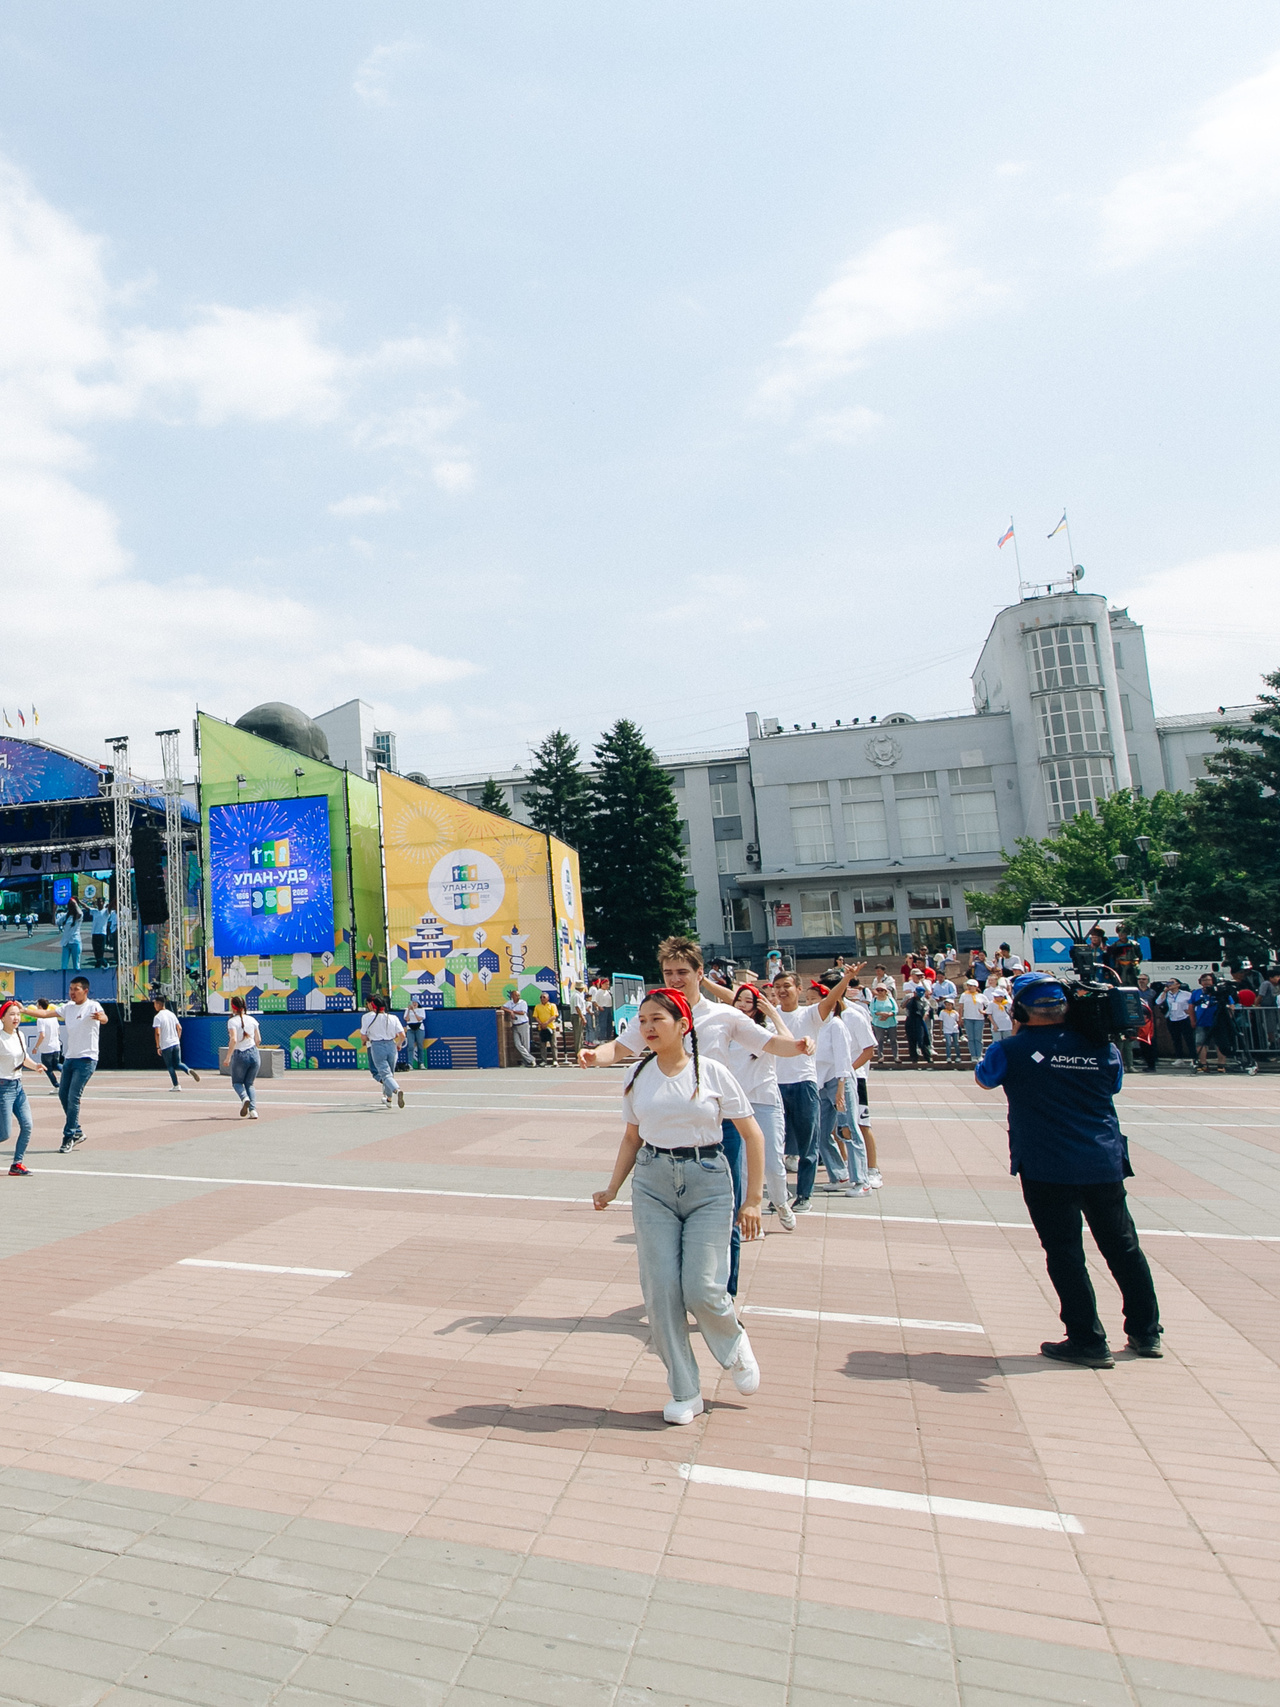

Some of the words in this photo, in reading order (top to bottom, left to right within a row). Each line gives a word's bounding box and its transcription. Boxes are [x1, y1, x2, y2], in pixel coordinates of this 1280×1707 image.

[233, 868, 308, 886] УЛАН-УДЭ
[292, 888, 309, 896] 2022
[442, 882, 490, 892] УЛАН-УДЭ
[1050, 1055, 1098, 1065] АРИГУС
